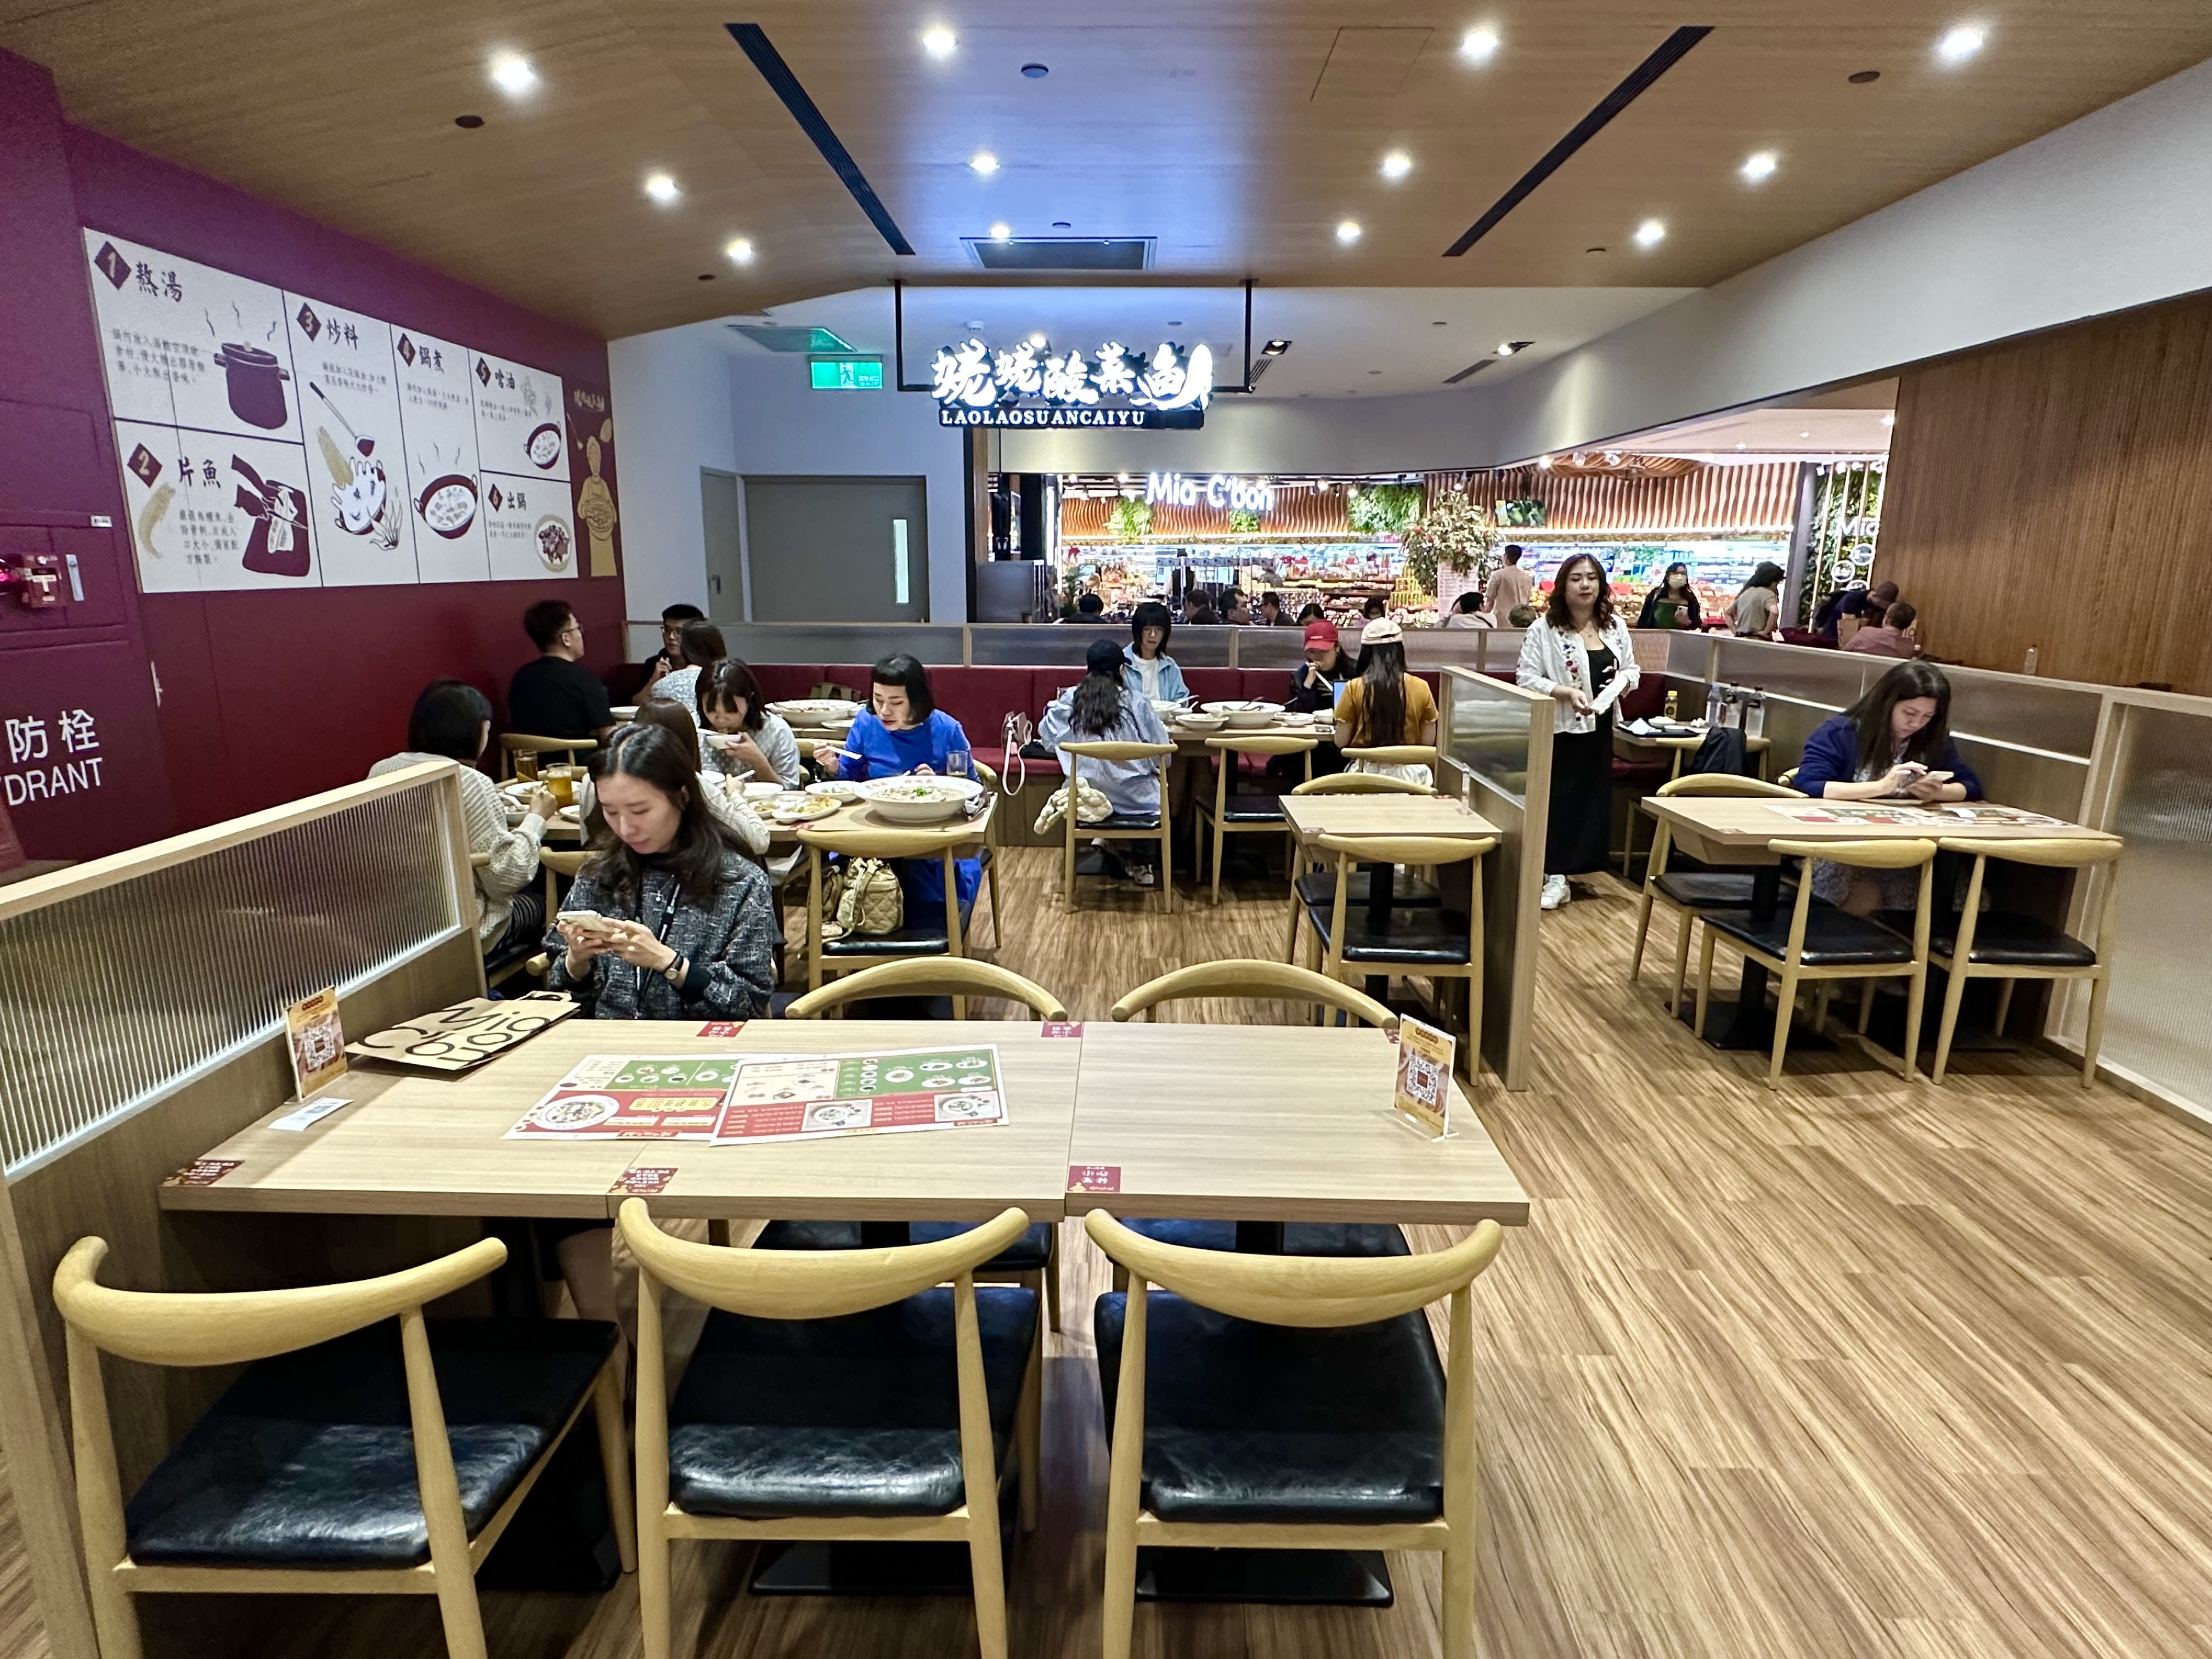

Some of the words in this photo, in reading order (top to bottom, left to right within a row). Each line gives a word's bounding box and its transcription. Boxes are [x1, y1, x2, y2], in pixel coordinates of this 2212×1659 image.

[108, 252, 116, 279] 1
[136, 261, 183, 302] 熬湯
[304, 311, 313, 332] 3
[326, 318, 358, 351] 炒料
[942, 409, 1145, 426] LAOLAOSUANCAIYU
[138, 449, 149, 476] 2
[178, 456, 221, 488] 片魚
[1146, 472, 1197, 506] Mia
[1206, 475, 1273, 511] C'bon
[1836, 517, 1880, 537] Mia
[5, 709, 100, 764] 防栓
[0, 757, 103, 806] DRANT
